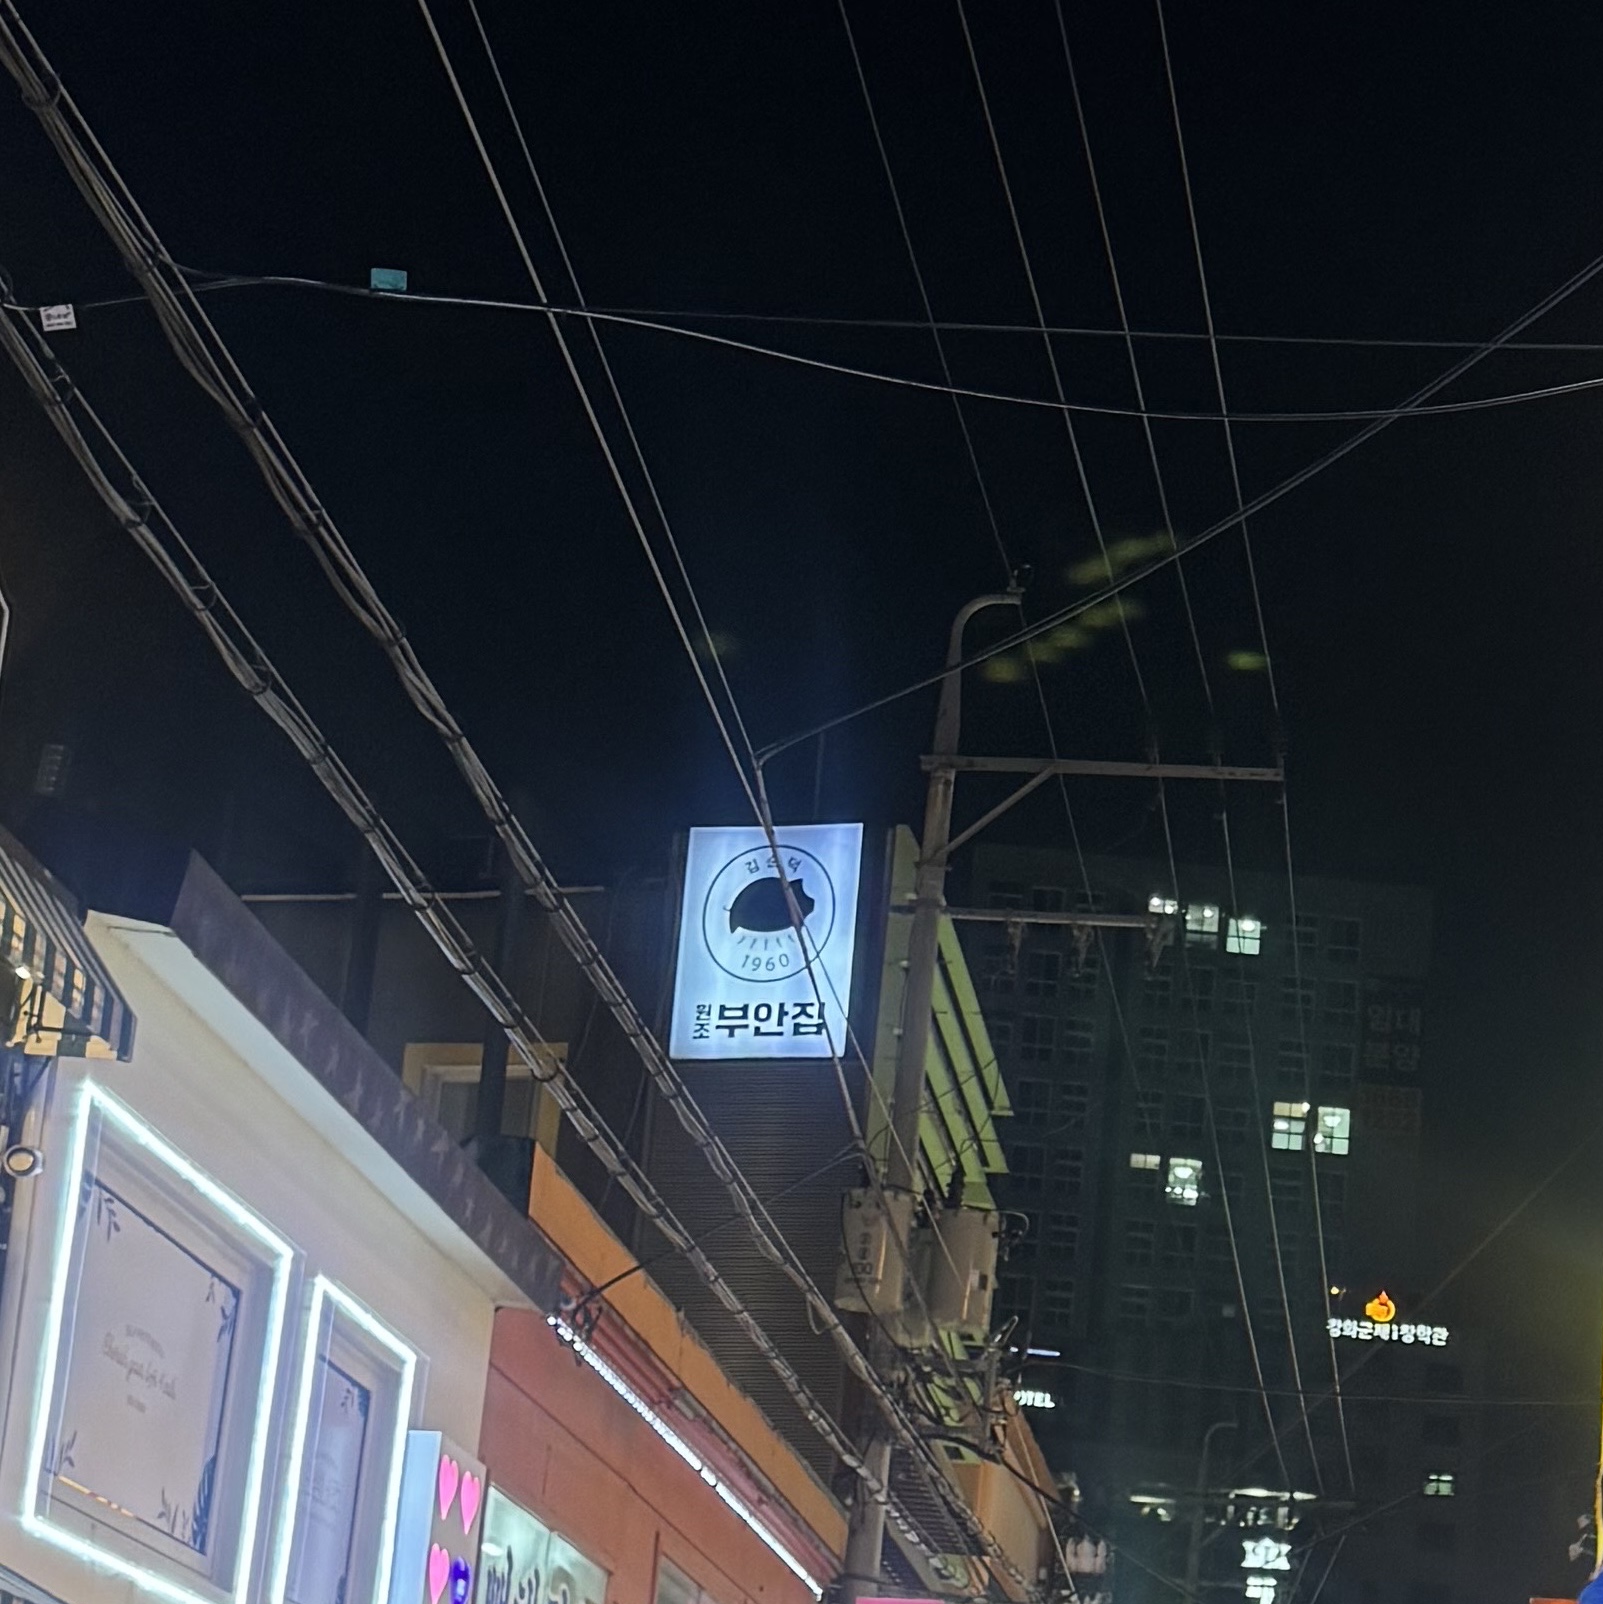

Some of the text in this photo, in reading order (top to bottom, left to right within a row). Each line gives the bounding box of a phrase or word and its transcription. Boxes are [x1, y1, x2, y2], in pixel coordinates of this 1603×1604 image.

[741, 952, 790, 973] 1960
[692, 1001, 827, 1040] 원조 부안집
